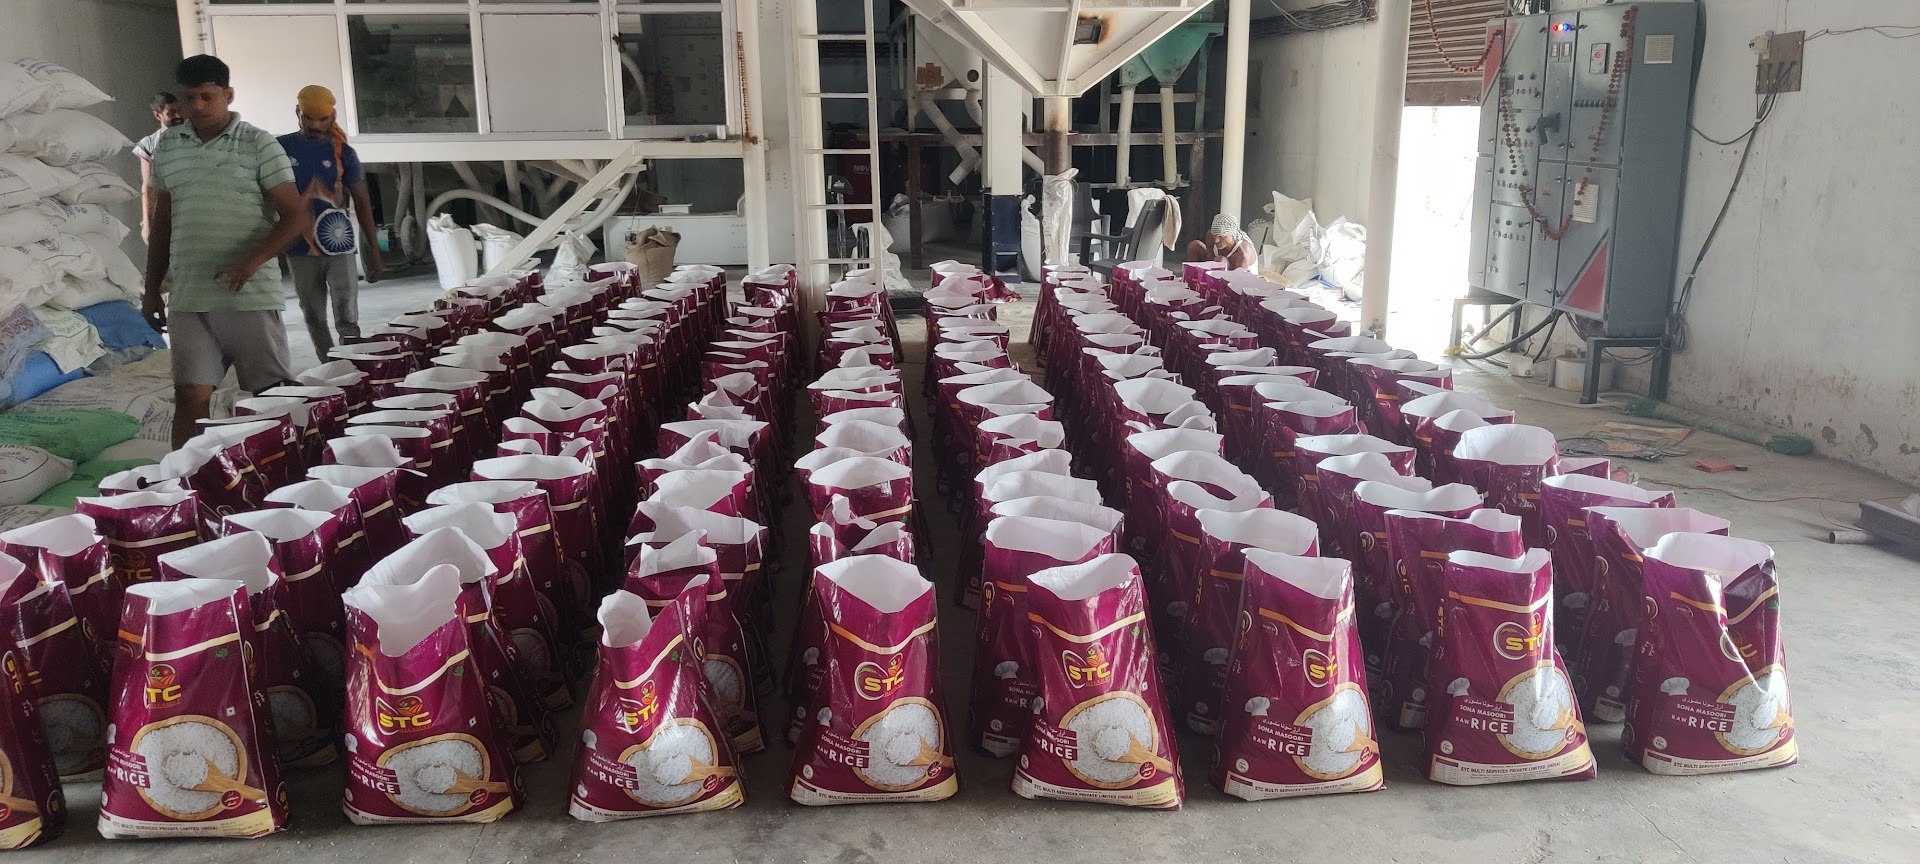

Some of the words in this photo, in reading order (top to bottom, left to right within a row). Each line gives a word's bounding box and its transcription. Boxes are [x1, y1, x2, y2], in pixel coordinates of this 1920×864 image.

[124, 568, 154, 581] TC
[864, 668, 905, 692] STC
[1068, 661, 1111, 681] STC
[1309, 662, 1338, 680] ST
[146, 684, 182, 704] TC
[378, 711, 432, 728] STC
[625, 695, 660, 727] STC
[1459, 704, 1476, 714] SONA
[1476, 709, 1507, 719] MASOORI
[1676, 703, 1695, 713] SONA
[1695, 708, 1727, 719] MASOORI
[1455, 716, 1470, 725] RAW
[1470, 717, 1509, 733] RICE
[1671, 714, 1687, 723] RAW
[1687, 715, 1728, 732] RICE
[1257, 724, 1274, 736] SONA
[1274, 730, 1304, 742] MASOORI
[820, 734, 835, 748] SONA
[834, 742, 862, 755] MASOORI
[1041, 739, 1074, 760] RICE
[1252, 735, 1267, 746] RAW
[1267, 738, 1306, 756] RICE
[817, 744, 829, 756] RAW
[828, 748, 865, 768] RICE
[115, 766, 147, 788] RICE
[599, 770, 635, 790] RICE
[602, 763, 630, 778] MASOORI
[361, 775, 396, 794] RICE
